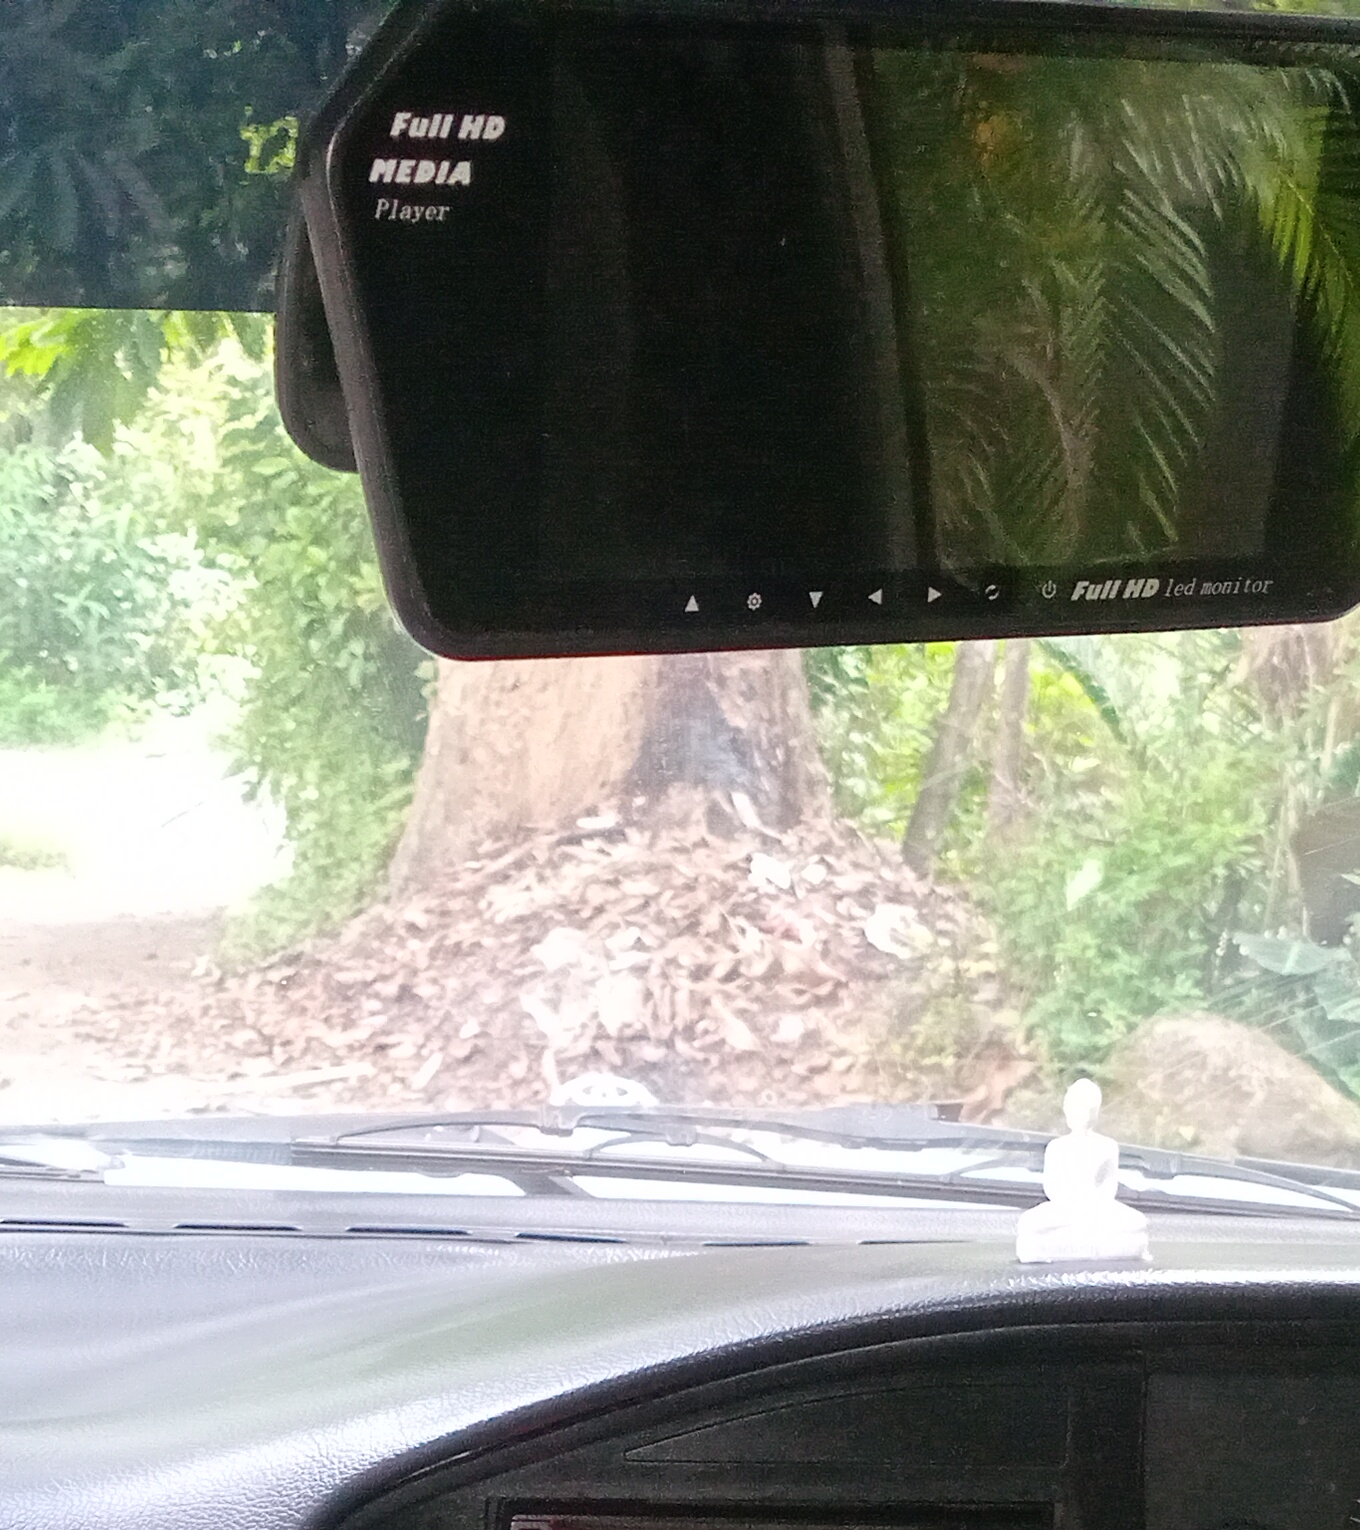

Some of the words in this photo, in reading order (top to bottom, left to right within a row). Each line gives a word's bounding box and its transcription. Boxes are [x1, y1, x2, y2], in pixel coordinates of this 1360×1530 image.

[390, 112, 454, 138] Full
[458, 114, 506, 139] HD
[368, 159, 471, 185] MEDIA
[374, 197, 451, 223] Player
[1070, 579, 1123, 601] Full
[1123, 578, 1159, 599] HD
[1163, 576, 1197, 598] led
[1200, 575, 1275, 597] monitor
